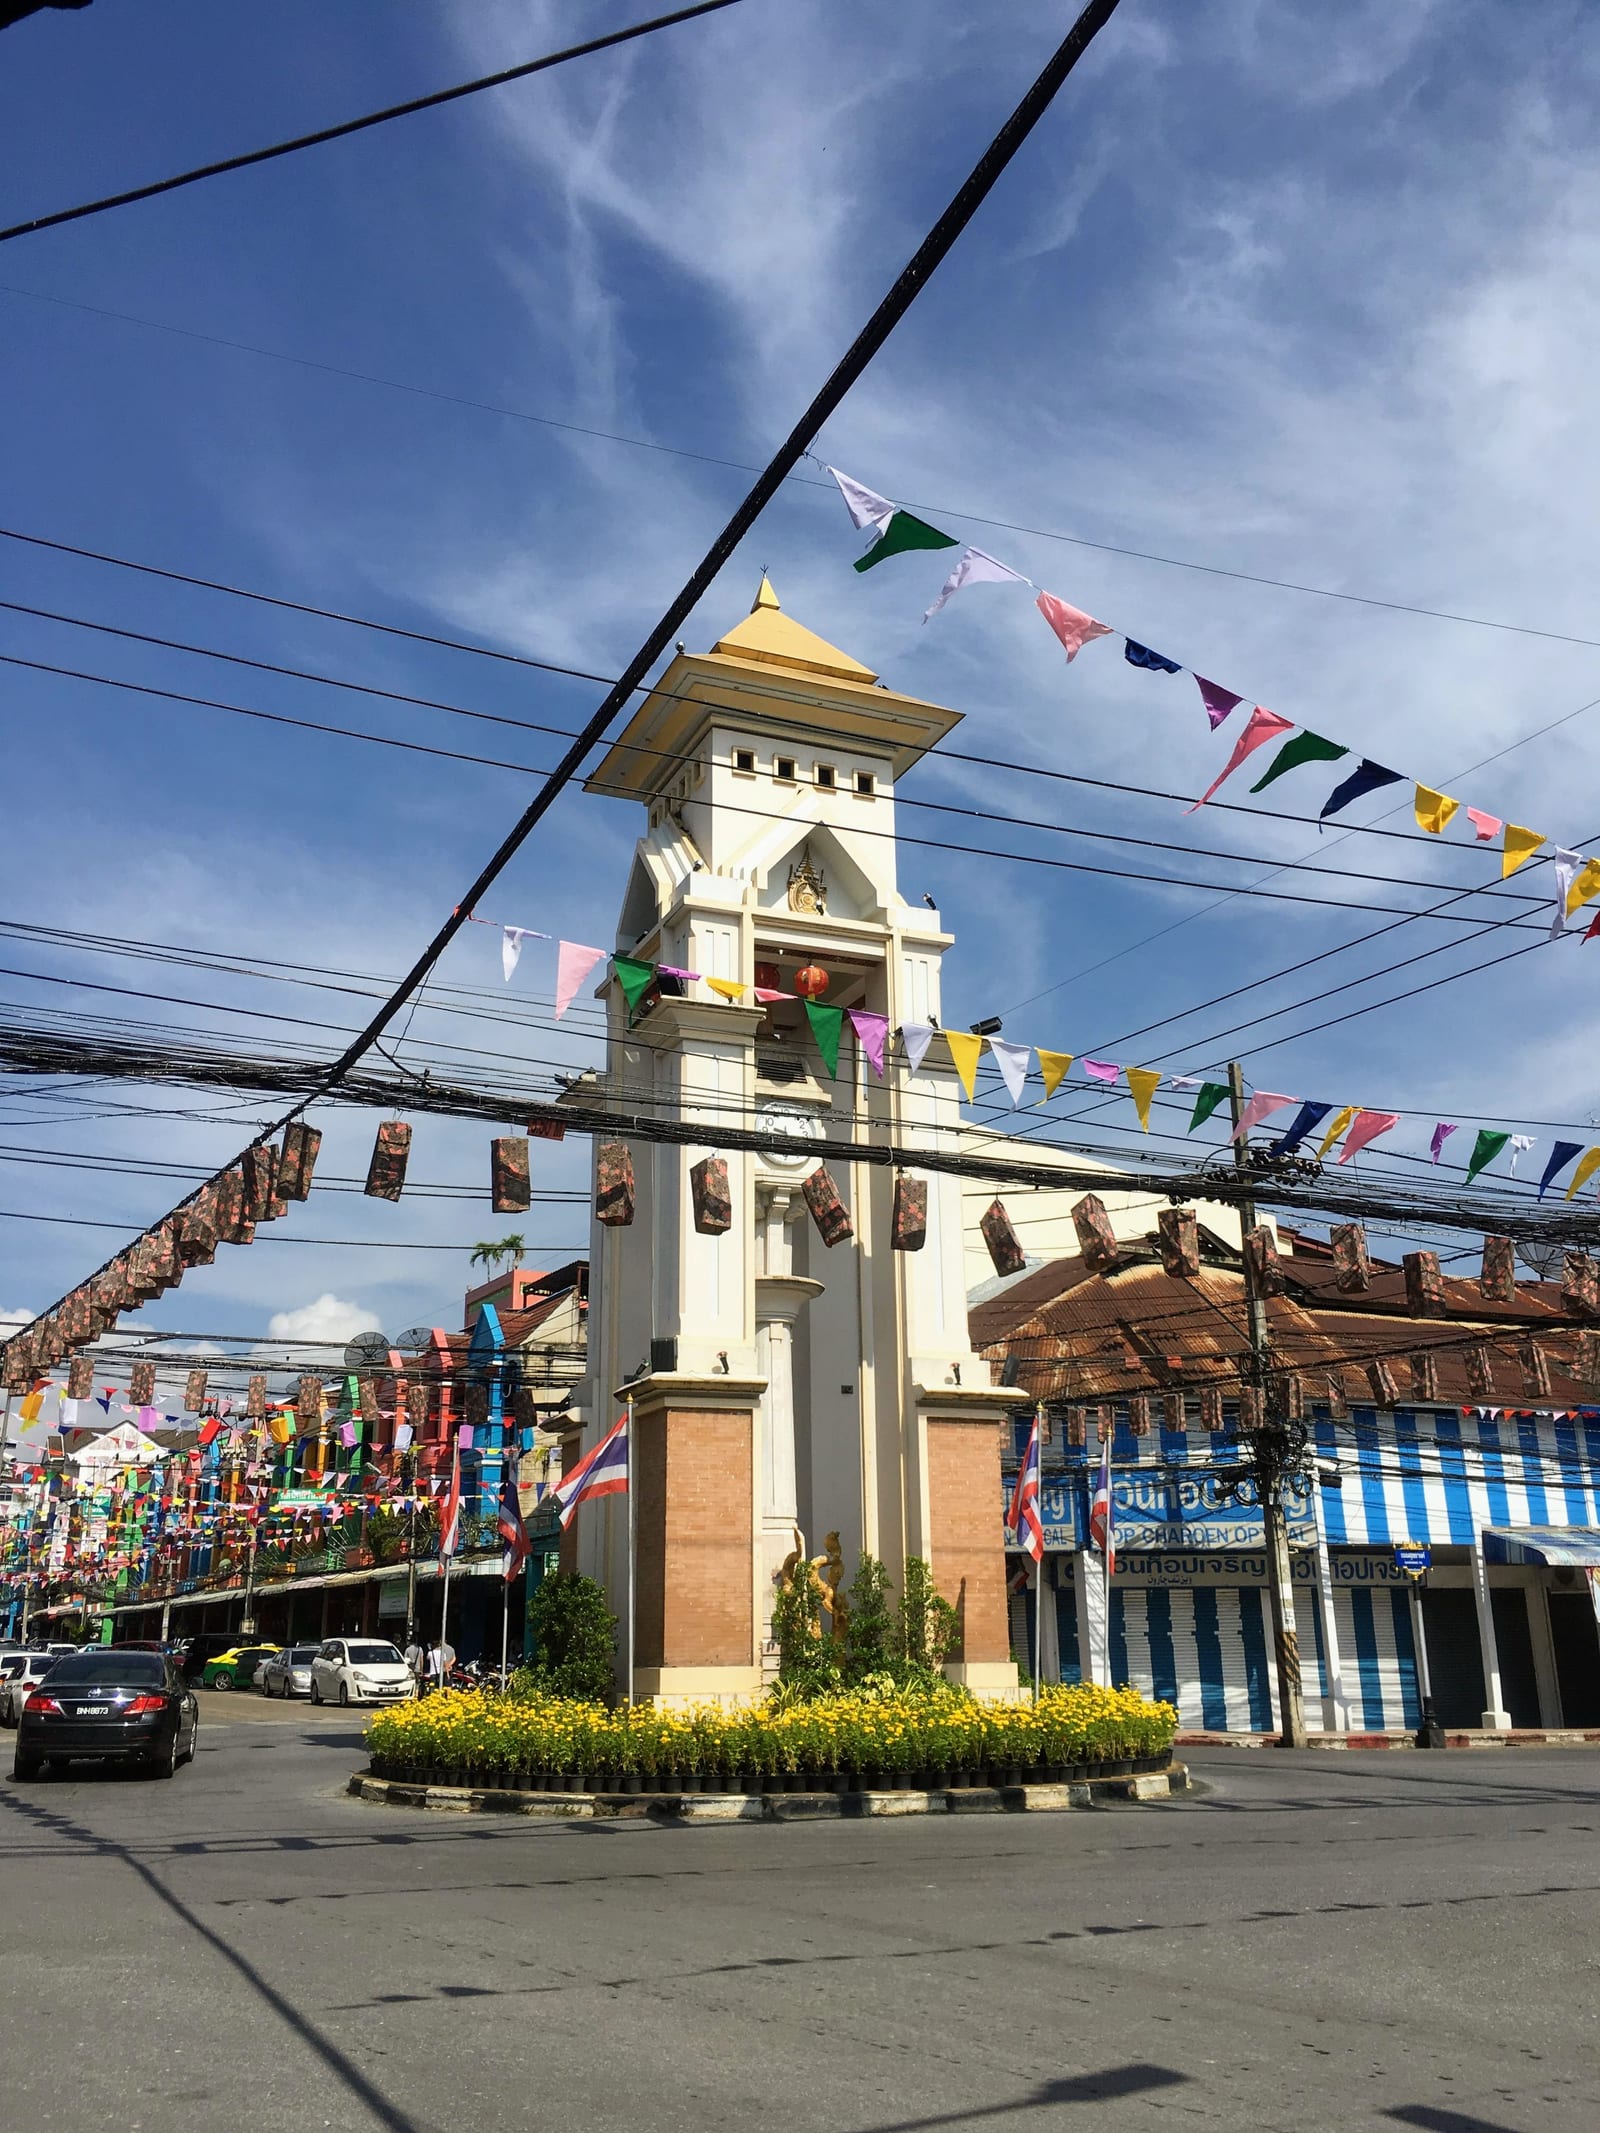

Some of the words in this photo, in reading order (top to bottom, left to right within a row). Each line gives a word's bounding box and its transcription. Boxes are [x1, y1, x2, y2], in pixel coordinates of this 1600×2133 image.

[1114, 1527, 1136, 1543] OP
[1141, 1527, 1229, 1544] CHAROEN
[1234, 1526, 1308, 1543] OPAL
[1114, 1556, 1265, 1577] ว่นท็อปเจริญ
